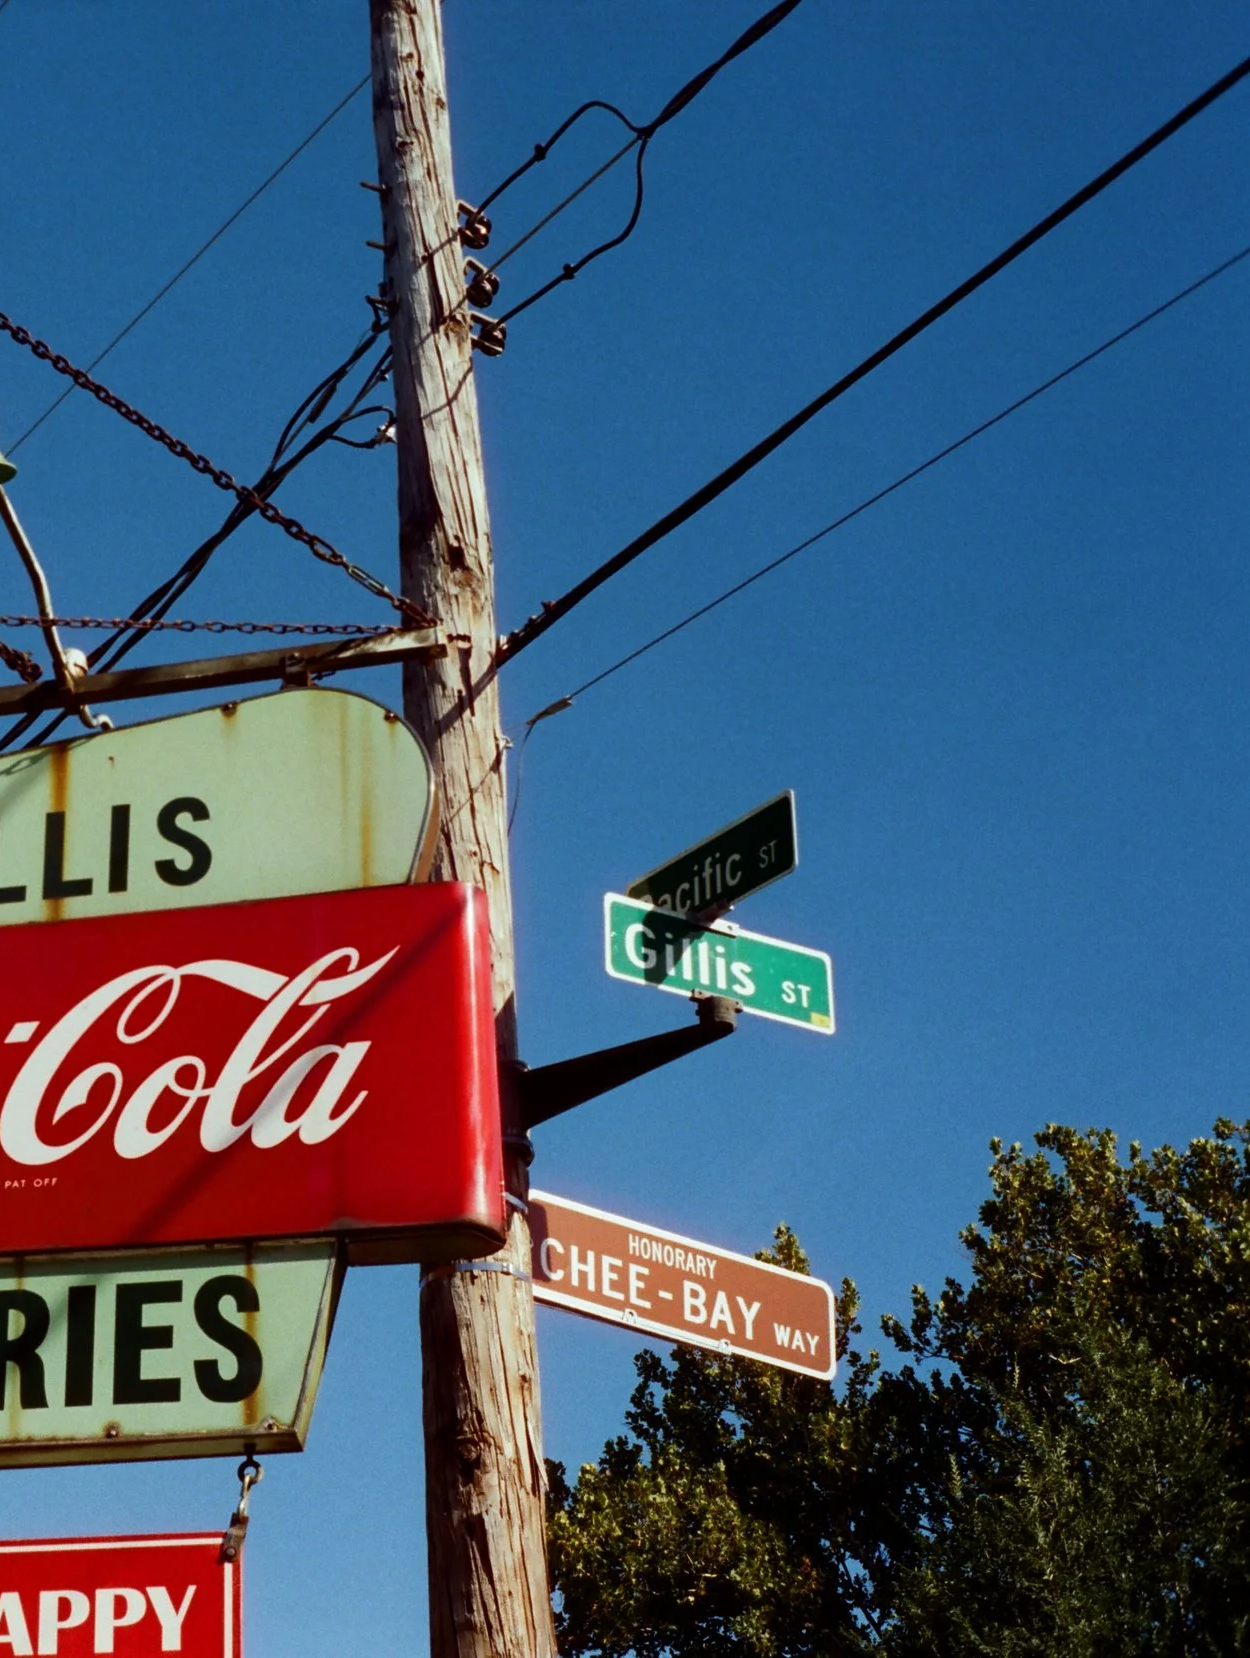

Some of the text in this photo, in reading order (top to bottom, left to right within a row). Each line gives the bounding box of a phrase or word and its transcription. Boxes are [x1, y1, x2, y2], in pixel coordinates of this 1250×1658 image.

[759, 839, 778, 868] ST
[624, 923, 812, 1008] Gillis ST
[4, 1179, 26, 1189] PAT
[33, 1177, 58, 1188] OFF
[628, 1233, 718, 1280] HONORARY
[540, 1237, 820, 1356] CHEE-BAY WAY
